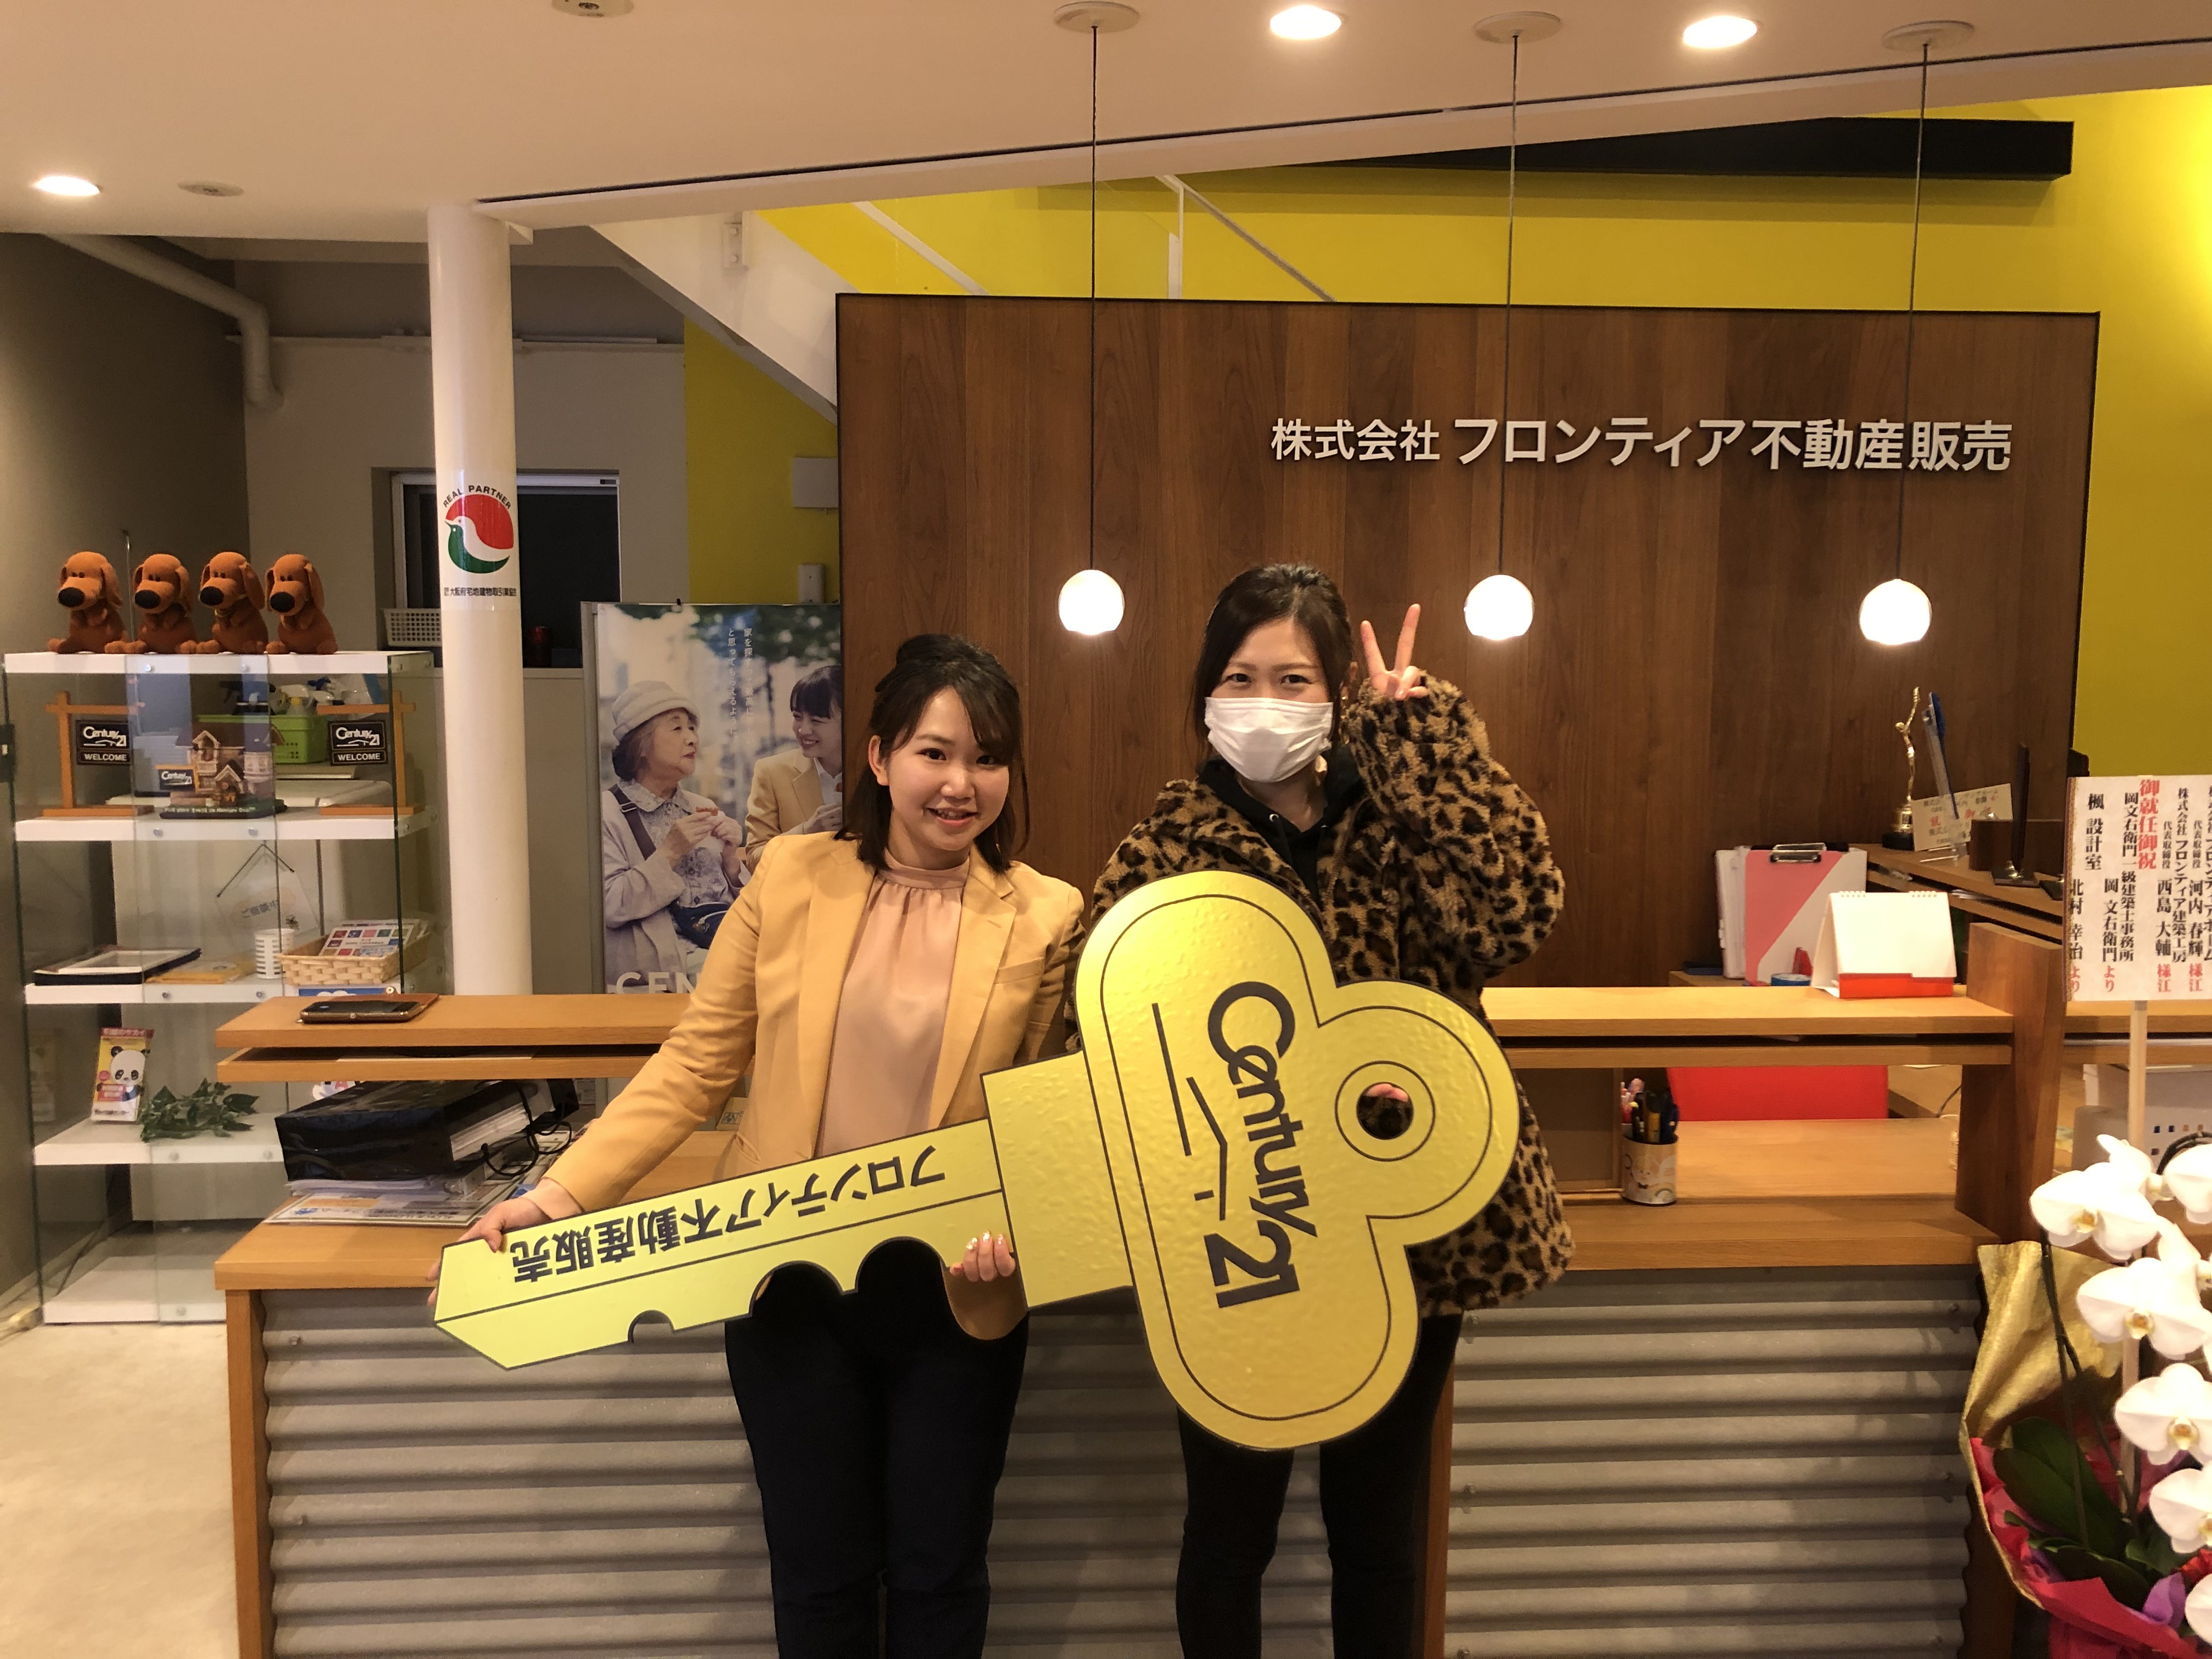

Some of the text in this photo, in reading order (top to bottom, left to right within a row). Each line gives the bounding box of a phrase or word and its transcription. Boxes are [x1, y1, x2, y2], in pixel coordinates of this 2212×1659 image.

[1271, 417, 2013, 471] 株式会社 フロンティア不動産販売
[443, 485, 511, 509] REAL PARTNER
[83, 726, 127, 747] Century 21
[84, 753, 127, 761] WELCOME
[336, 727, 380, 746] Century 21
[338, 753, 381, 761] WELCOME
[2085, 793, 2105, 871] 楓 設計室
[2138, 779, 2160, 870] 御就任御祝
[2192, 821, 2203, 868] 代表取締役
[2119, 792, 2139, 962] 岡文右衛門一級建築士事務所
[2155, 821, 2172, 992] 代表取締役 西島 大輔 様江
[2171, 787, 2189, 963] 株式会社 フロンティア建築工房
[2188, 879, 2203, 915] 河内
[2069, 878, 2084, 992] 北村 幸治 より
[2102, 878, 2119, 992] 岡 文右衛門 より
[2189, 963, 2203, 992] 様江
[1203, 980, 1318, 1309] Century 21
[510, 1145, 946, 1283] フロンティア不動産販売
